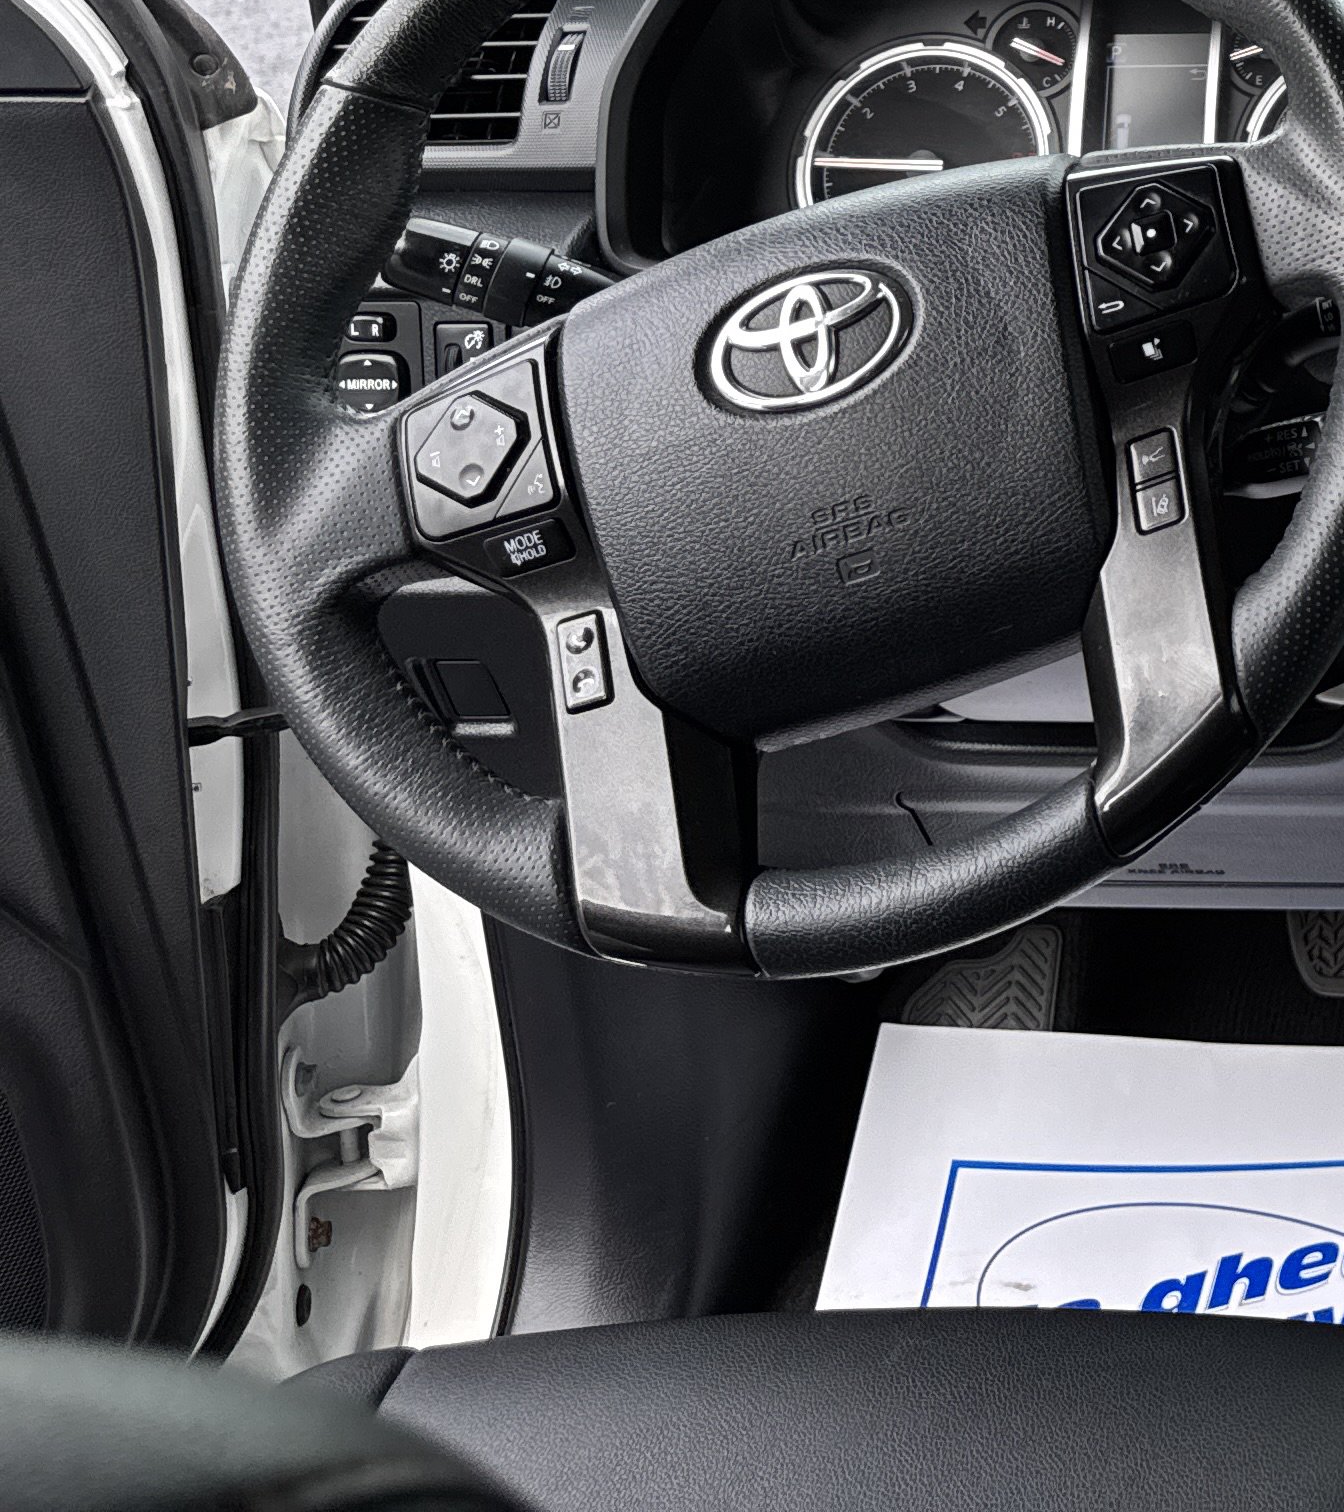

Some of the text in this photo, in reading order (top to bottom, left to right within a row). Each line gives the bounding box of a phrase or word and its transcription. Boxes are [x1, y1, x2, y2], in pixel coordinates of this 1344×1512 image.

[1046, 17, 1056, 26] H
[953, 80, 965, 92] 4
[1255, 75, 1263, 85] E
[906, 80, 917, 93] 3
[861, 107, 875, 120] 2
[994, 106, 1007, 118] 5
[463, 274, 484, 288] DRL
[459, 292, 478, 304] OFF
[536, 294, 556, 305] OFF
[350, 323, 380, 336] L R
[346, 378, 391, 390] MIRROR
[503, 530, 544, 554] MODE
[520, 545, 547, 563] HOLD
